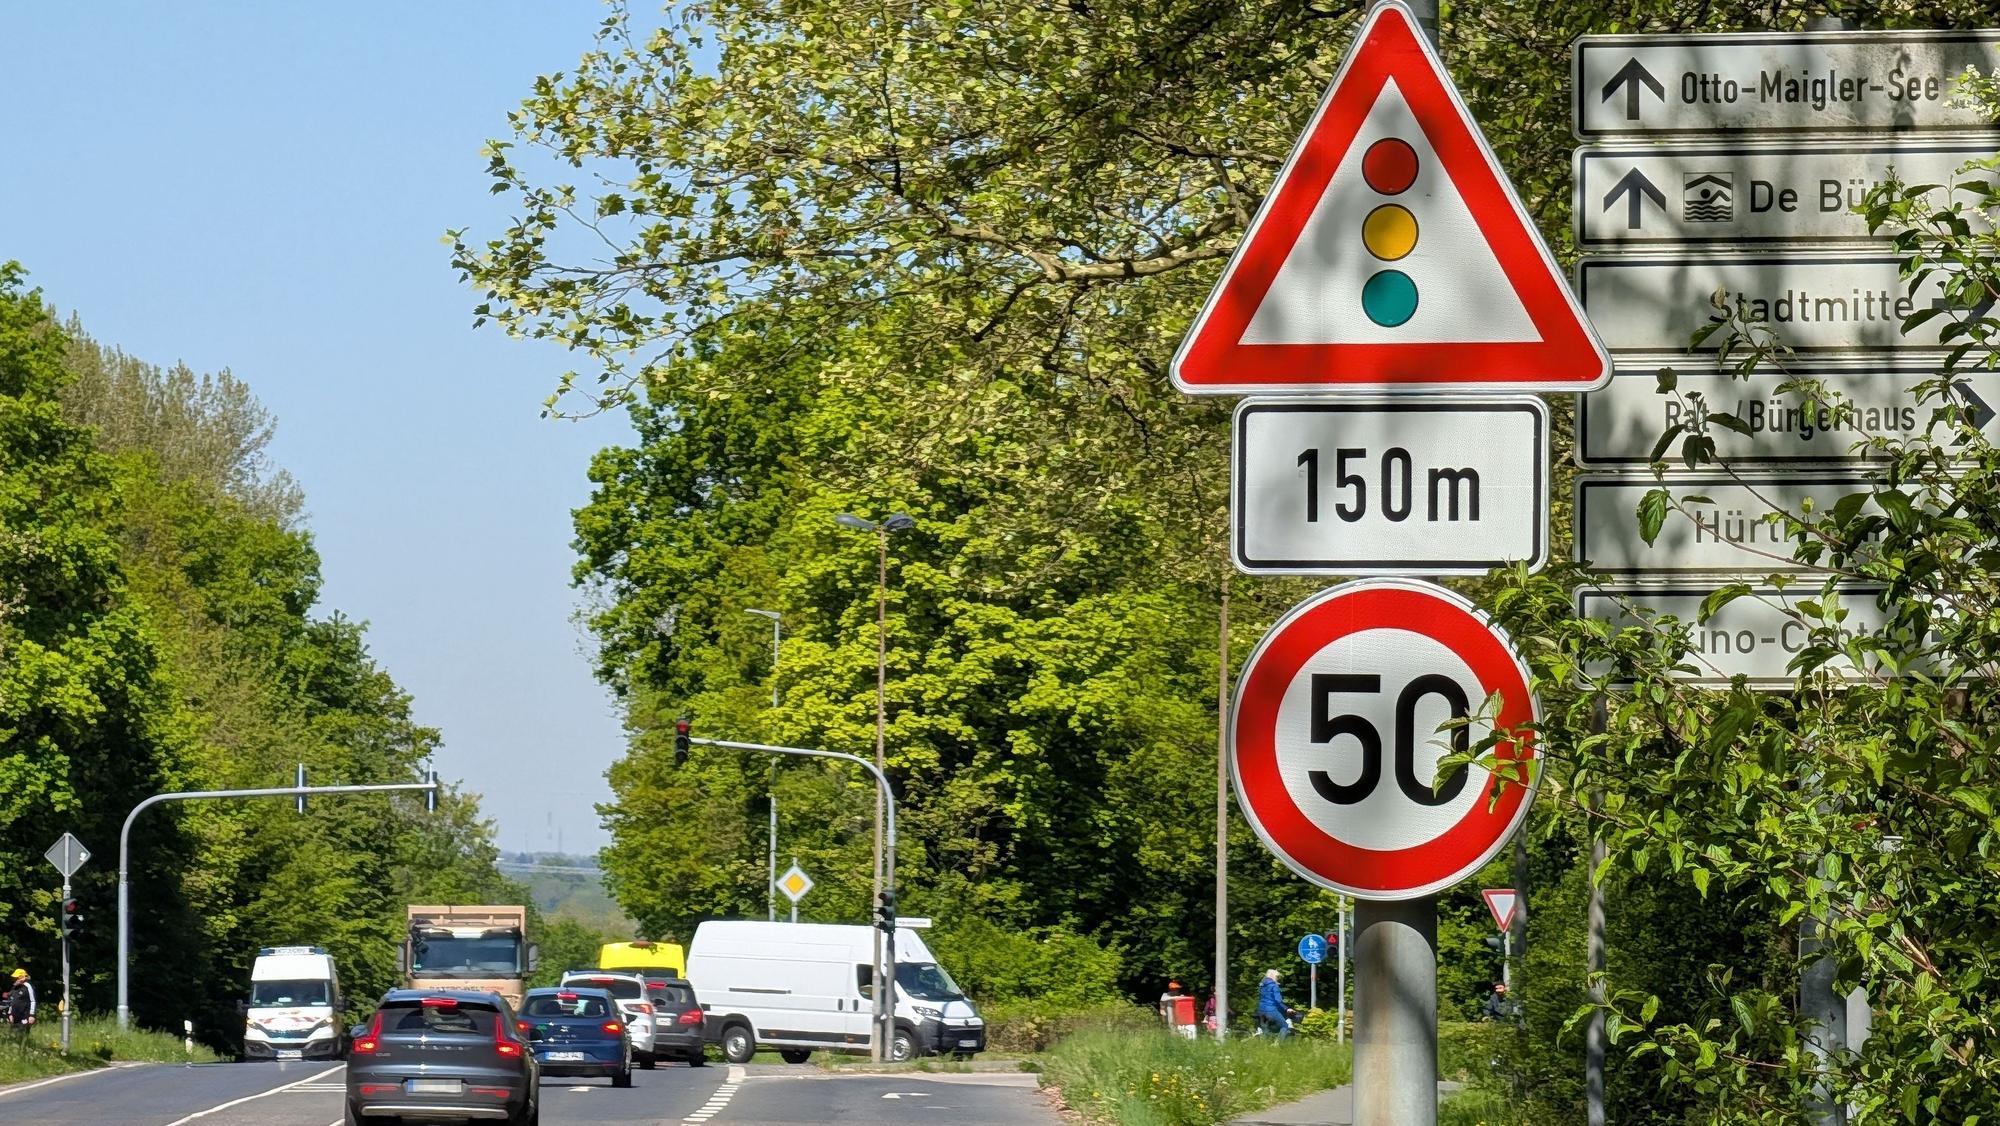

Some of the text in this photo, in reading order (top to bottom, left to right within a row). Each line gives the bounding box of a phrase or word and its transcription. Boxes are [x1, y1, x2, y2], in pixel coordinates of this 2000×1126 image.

[1681, 68, 1940, 112] Otto-Maigler-See
[1750, 178, 1898, 213] De Bü
[1709, 288, 1914, 323] Stadtmitte
[1308, 673, 1470, 807] 50
